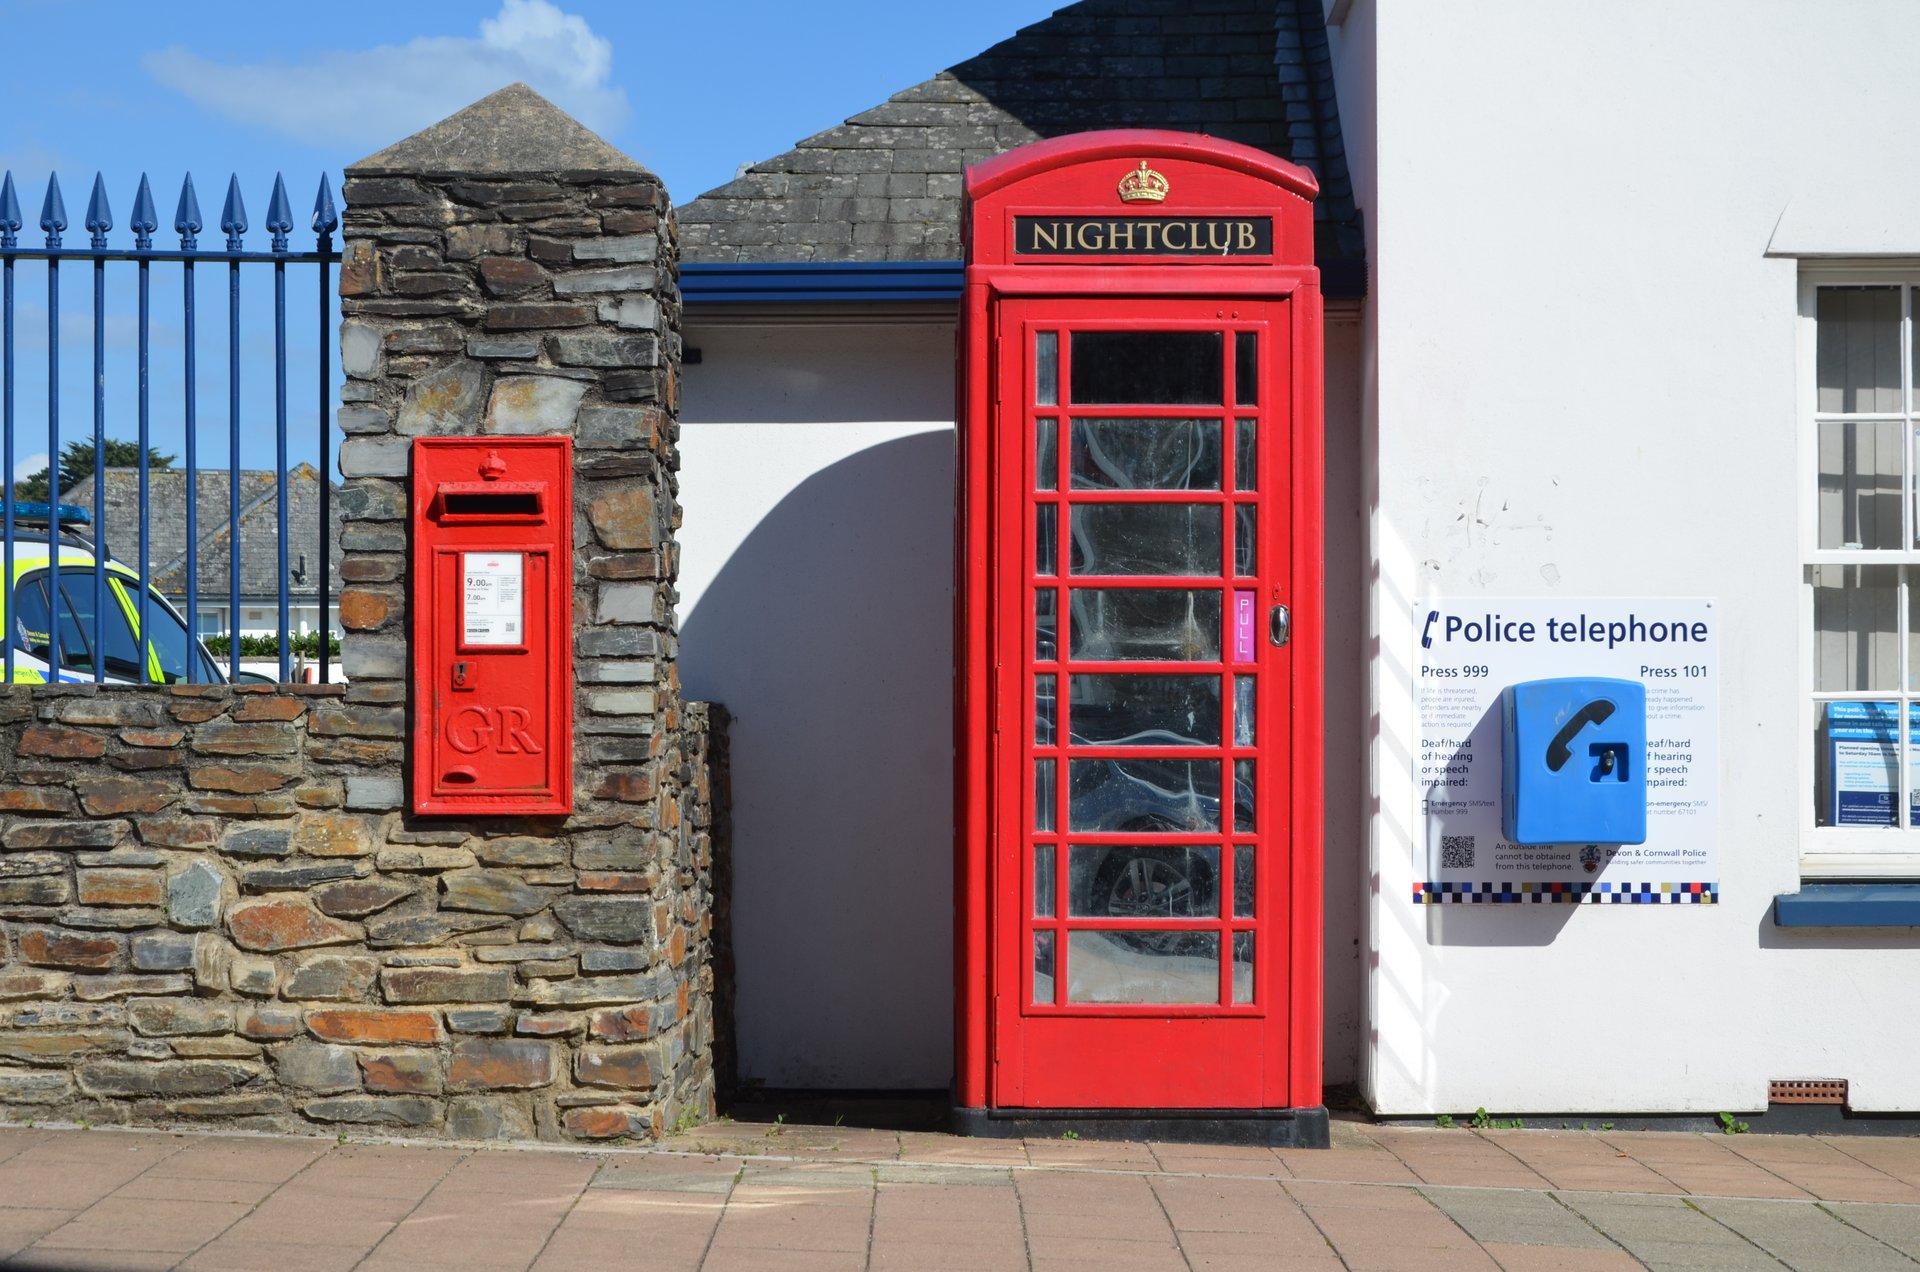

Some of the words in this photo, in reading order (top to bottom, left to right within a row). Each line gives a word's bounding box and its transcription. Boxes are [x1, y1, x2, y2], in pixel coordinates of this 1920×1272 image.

[1031, 222, 1256, 250] NIGHTCLUB
[1240, 599, 1249, 653] PULL
[1445, 614, 1536, 642] Police
[1546, 614, 1708, 649] telephone
[1421, 665, 1458, 678] Press
[1463, 665, 1489, 678] 999
[1640, 665, 1678, 678] Press
[1683, 665, 1707, 678] 101
[445, 705, 543, 755] GR
[1421, 739, 1472, 748] Deaf/hard
[1646, 739, 1691, 748] eaf/hard
[1421, 752, 1432, 761] of
[1435, 752, 1473, 763] hearing
[1654, 752, 1692, 763] hearing
[1421, 766, 1432, 774] or
[1435, 765, 1469, 776] speech
[1654, 765, 1688, 776] speech
[1421, 778, 1468, 789] impaired:
[1646, 778, 1688, 789] mpaired:
[1524, 852, 1534, 860] be
[1536, 852, 1571, 860] obtained
[1606, 849, 1632, 857] Devon
[1635, 849, 1642, 857] &
[1643, 849, 1680, 857] Cornwall
[1682, 849, 1707, 857] Police
[1532, 863, 1574, 872] telephone.
